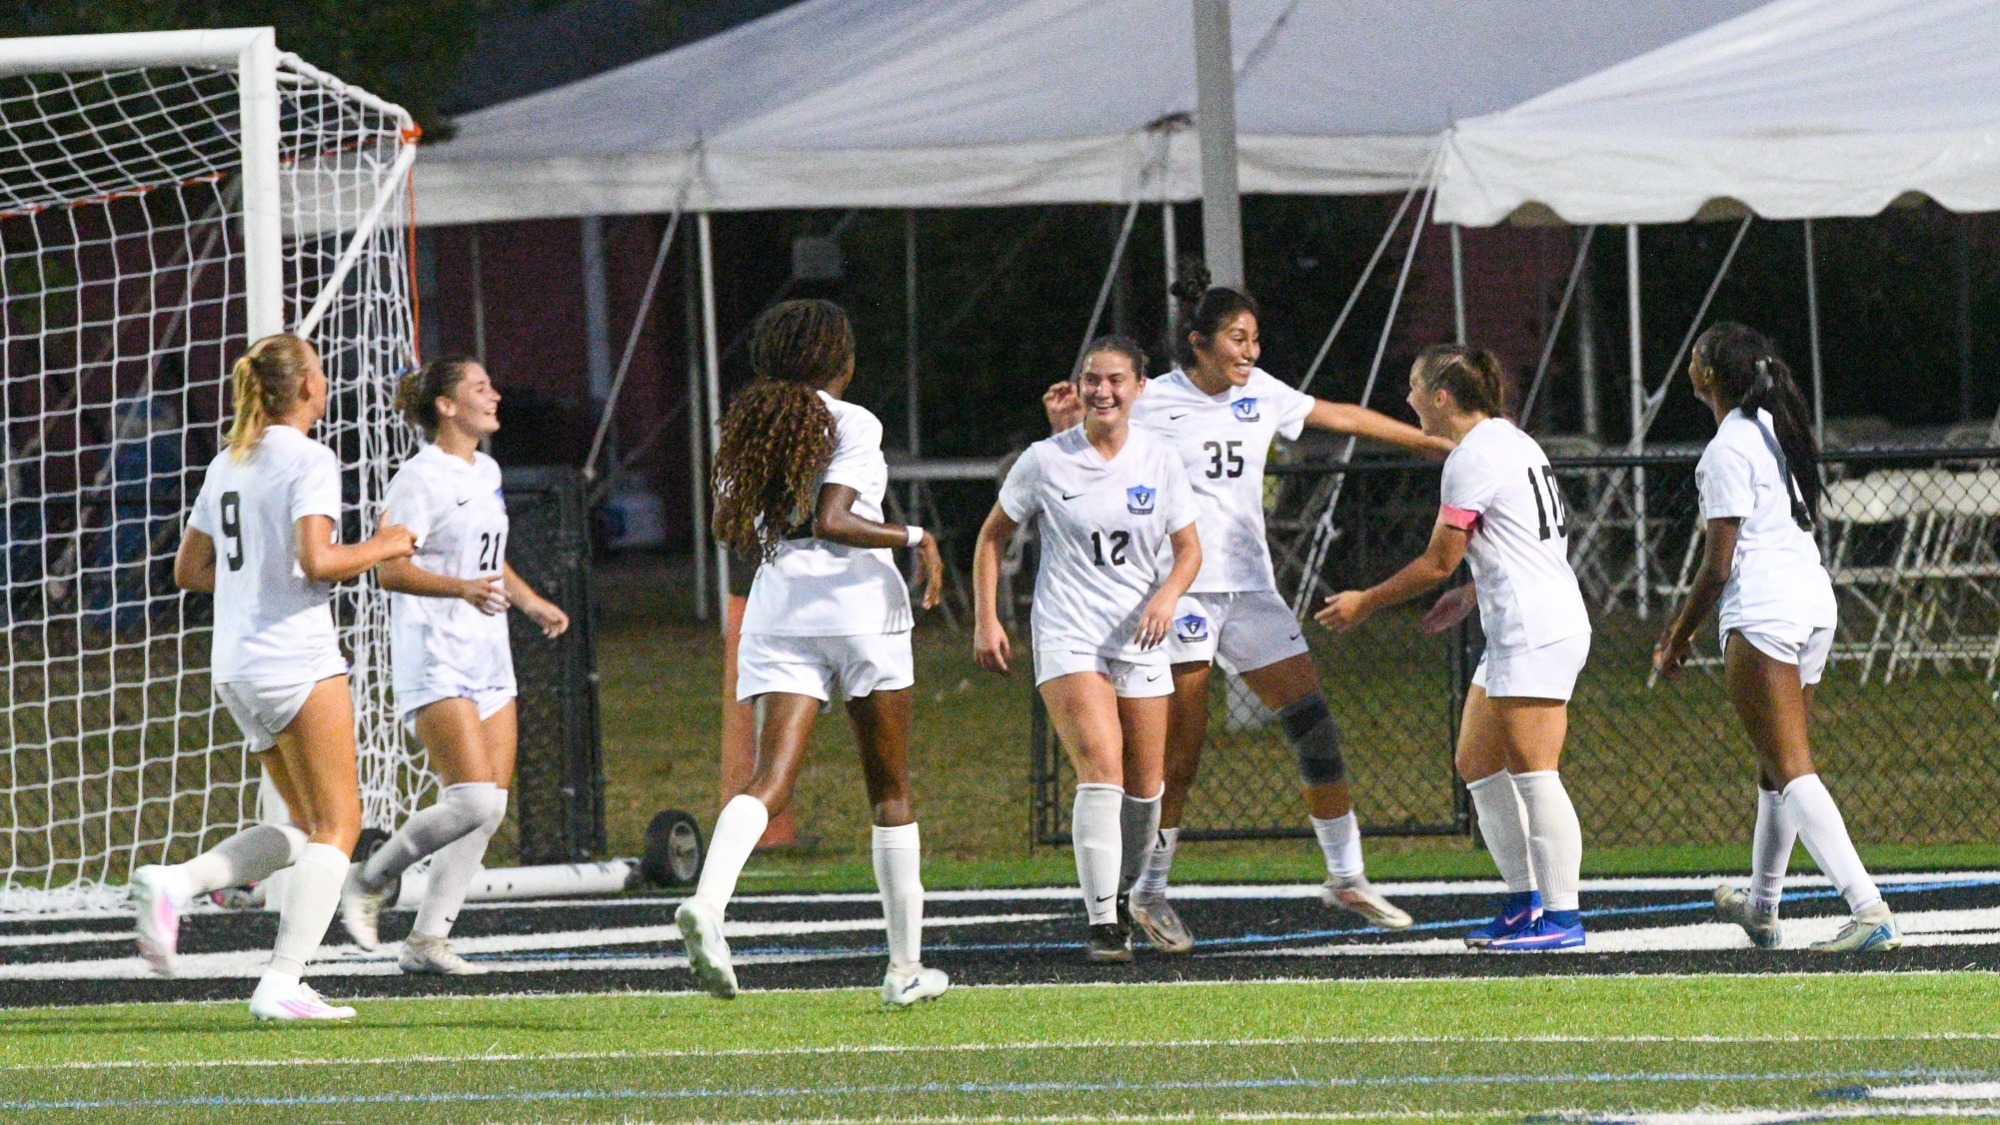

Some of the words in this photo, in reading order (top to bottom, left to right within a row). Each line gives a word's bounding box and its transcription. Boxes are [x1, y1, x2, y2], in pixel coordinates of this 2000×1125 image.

[1203, 440, 1244, 479] 35
[1527, 464, 1567, 541] 10
[220, 491, 244, 571] 9
[1091, 530, 1130, 566] 12
[479, 532, 500, 571] 21
